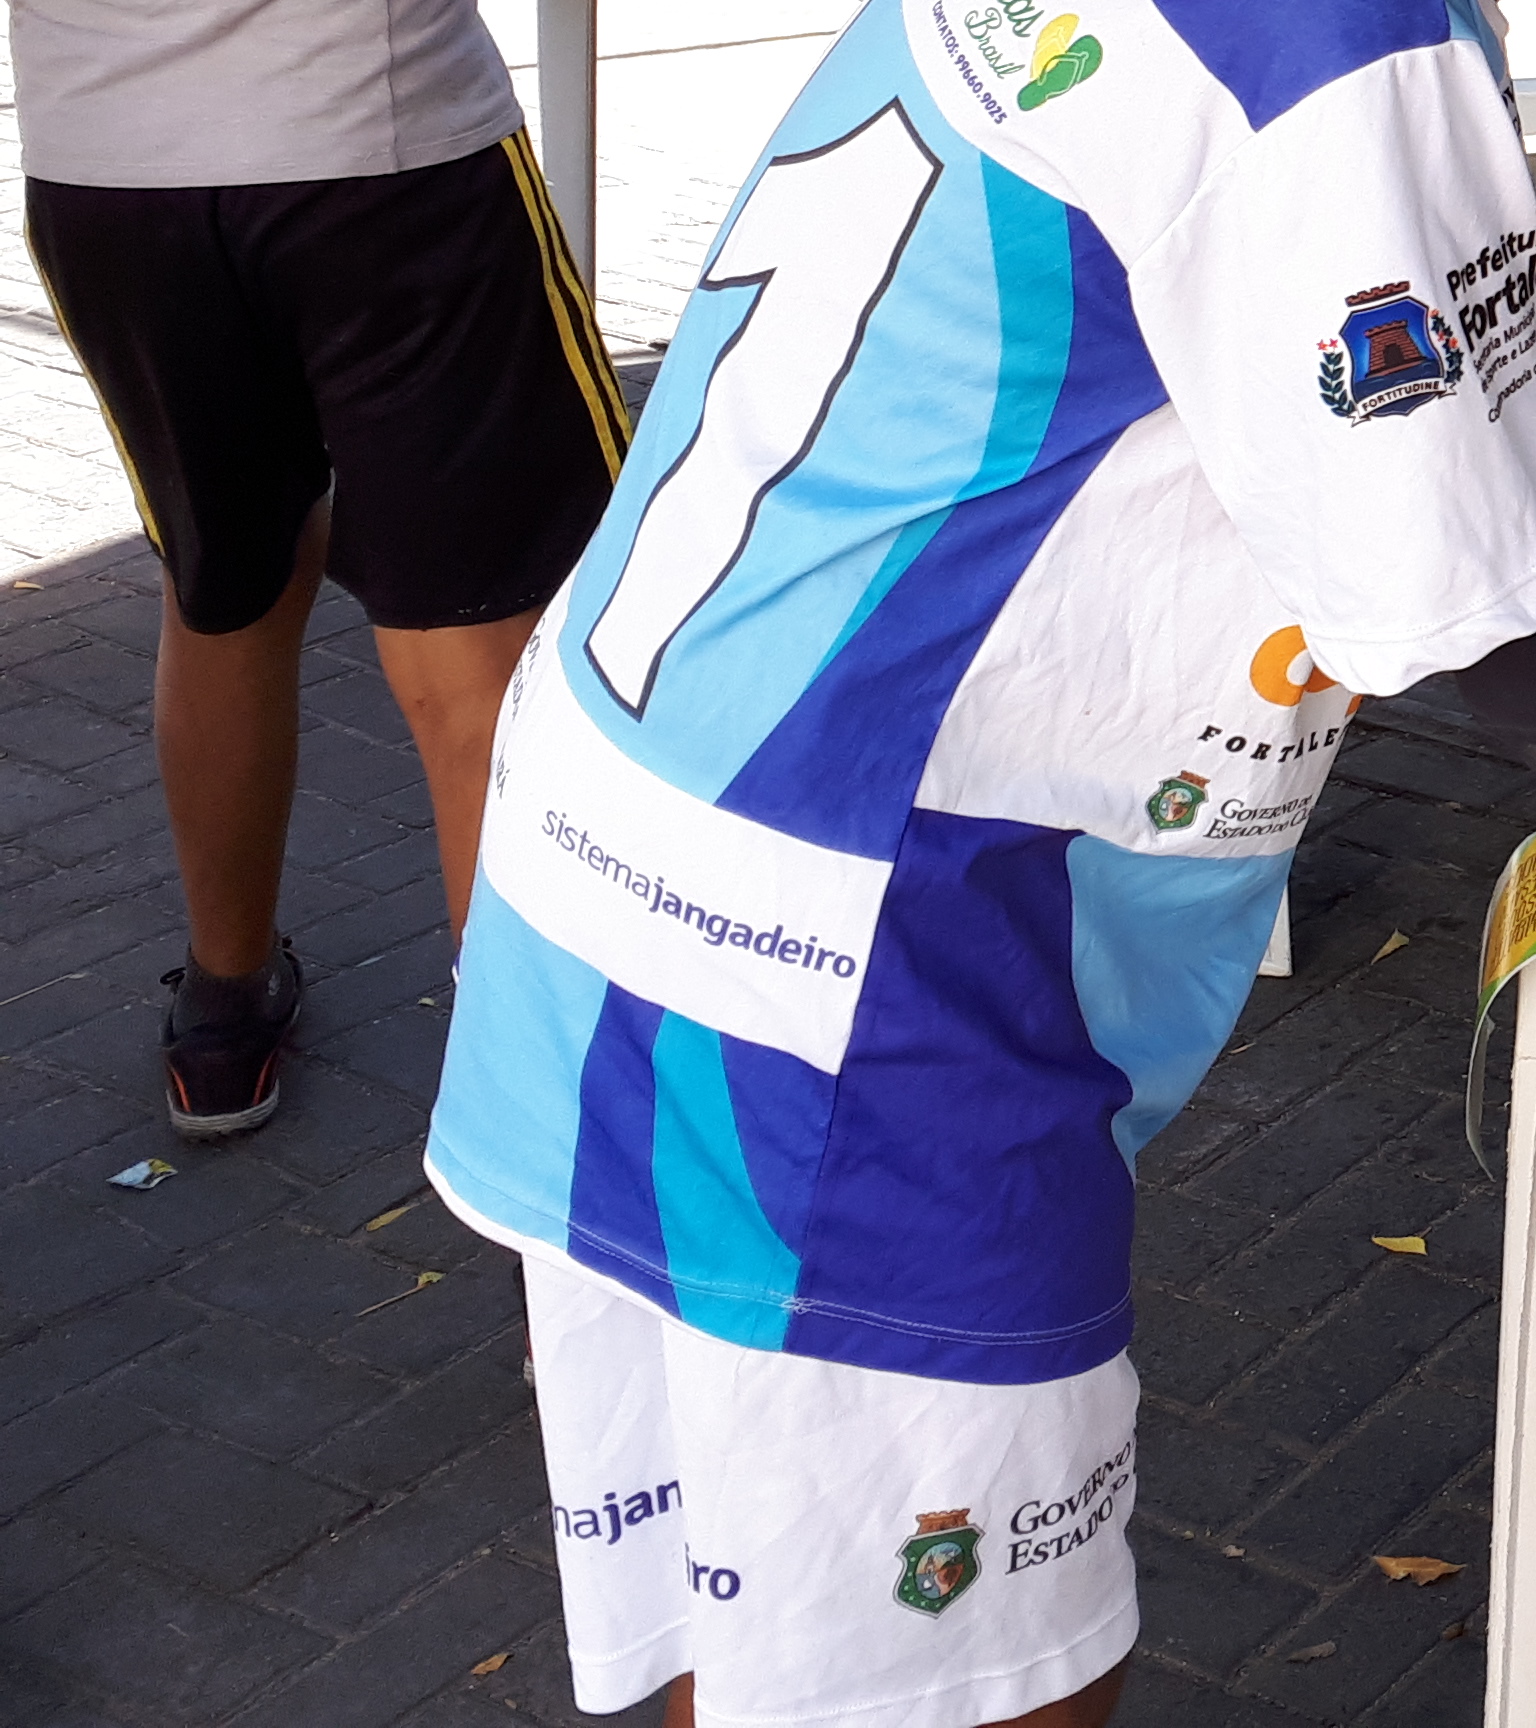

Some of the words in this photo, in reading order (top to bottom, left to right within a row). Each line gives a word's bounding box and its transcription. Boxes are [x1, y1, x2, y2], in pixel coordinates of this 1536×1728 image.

[932, 0, 960, 58] CONTATOS:
[954, 54, 1008, 124] 99660.9025
[964, 7, 1025, 79] Brasil
[1362, 381, 1440, 411] FORTITUDINE
[539, 805, 858, 982] sistemajangadeiro
